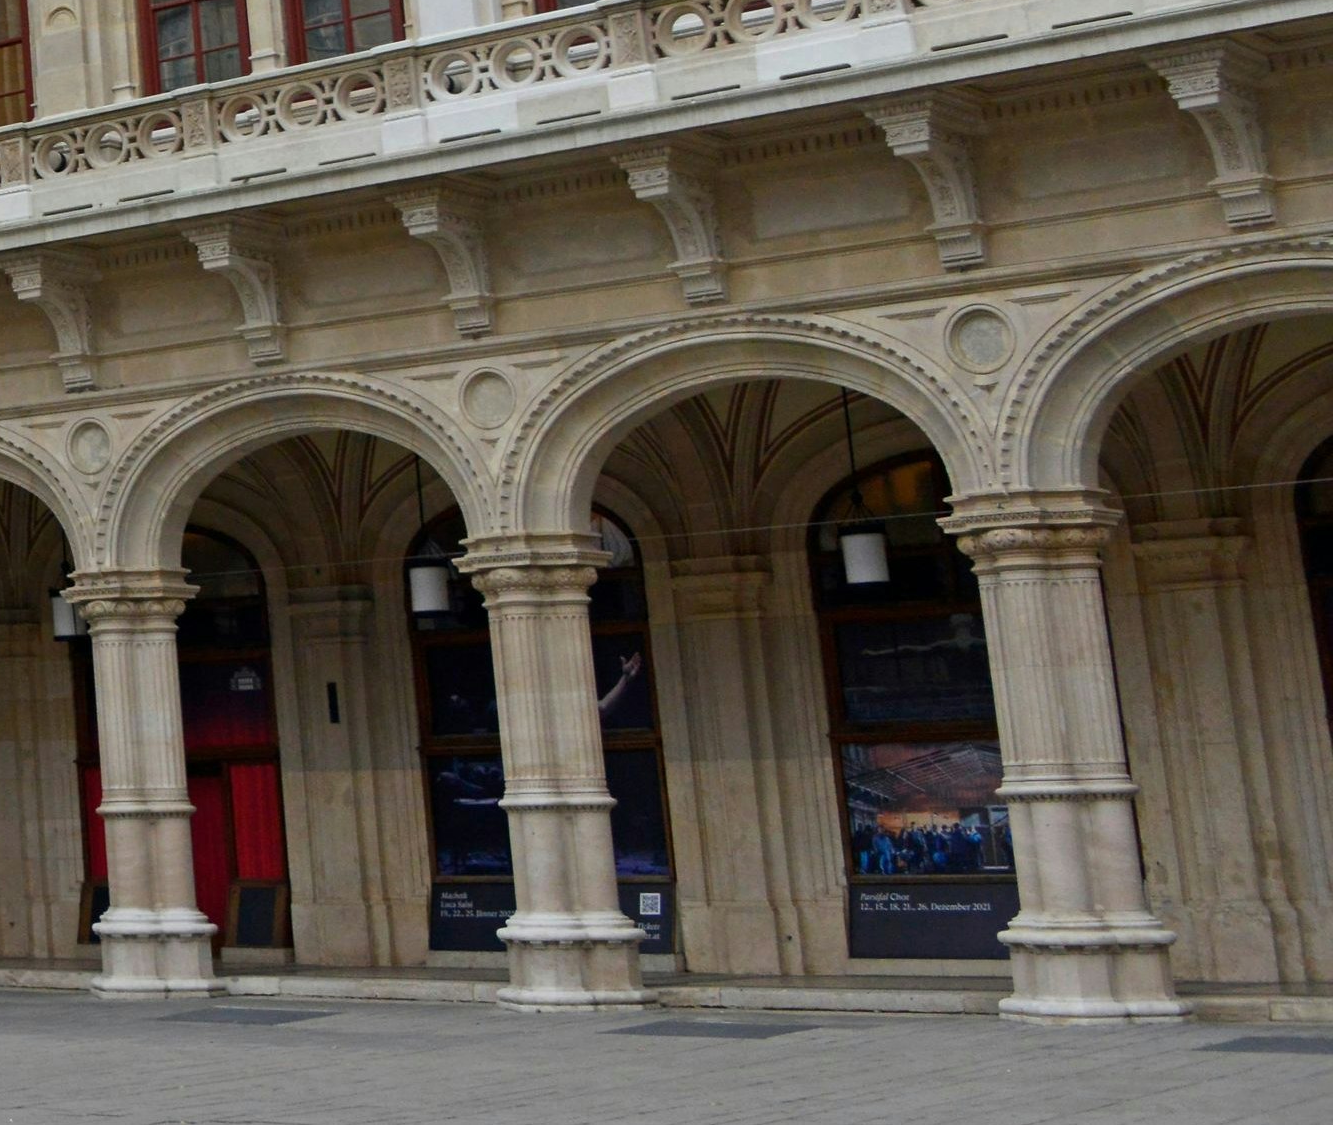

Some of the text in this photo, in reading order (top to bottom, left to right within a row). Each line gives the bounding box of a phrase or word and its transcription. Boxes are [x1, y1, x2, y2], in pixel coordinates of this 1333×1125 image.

[860, 893, 889, 902] Parsifal
[860, 903, 873, 911] 12.,
[930, 903, 971, 911] Dezember
[972, 903, 991, 911] 2021
